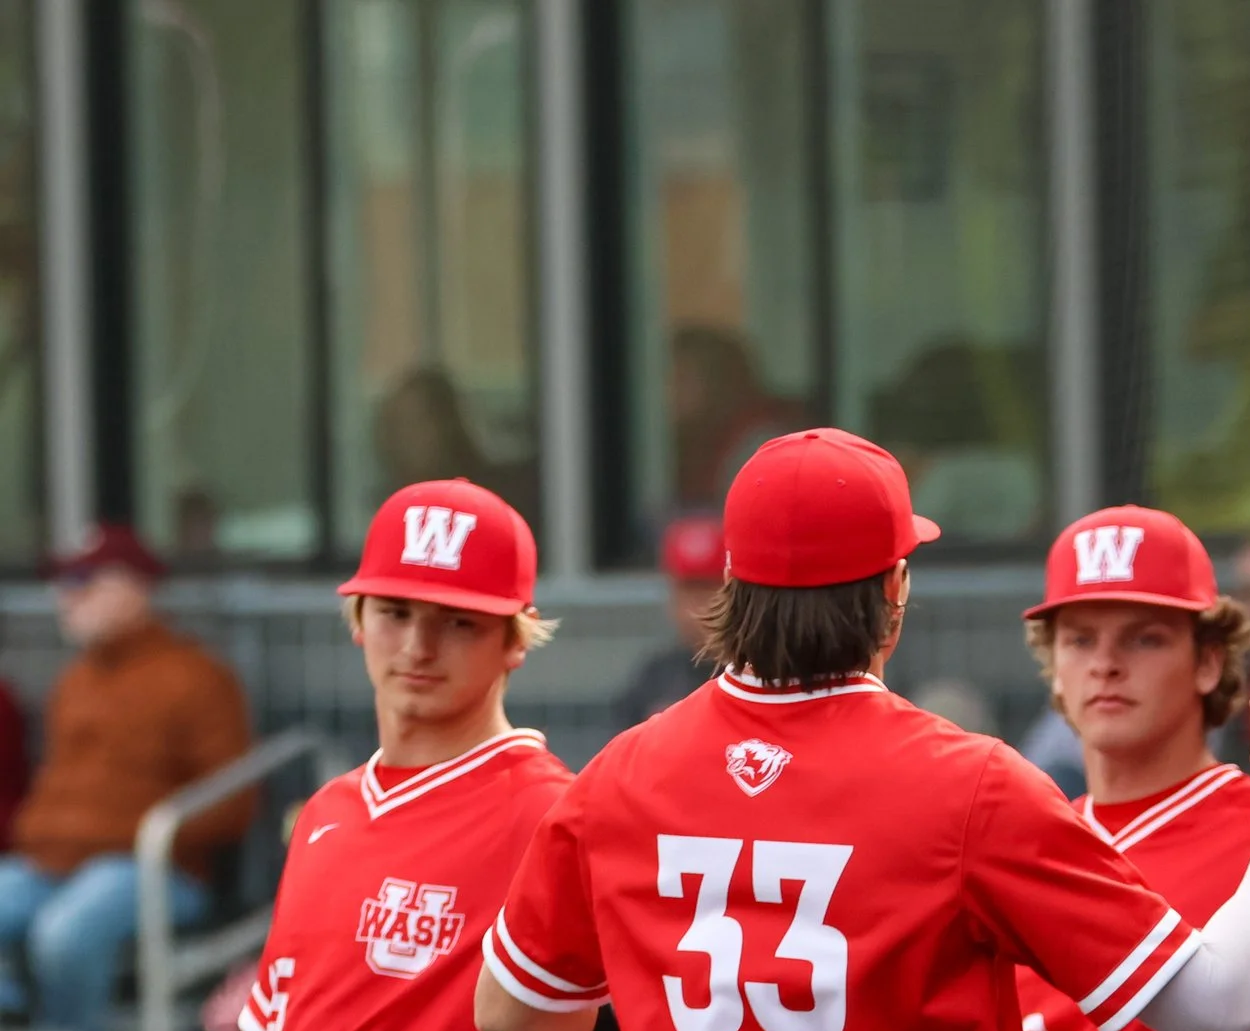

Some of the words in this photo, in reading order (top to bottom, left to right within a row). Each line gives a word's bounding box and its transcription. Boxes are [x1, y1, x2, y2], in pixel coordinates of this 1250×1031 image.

[400, 505, 478, 571] W
[1073, 525, 1145, 586] W
[355, 897, 465, 955] WASH
[365, 877, 458, 980] U
